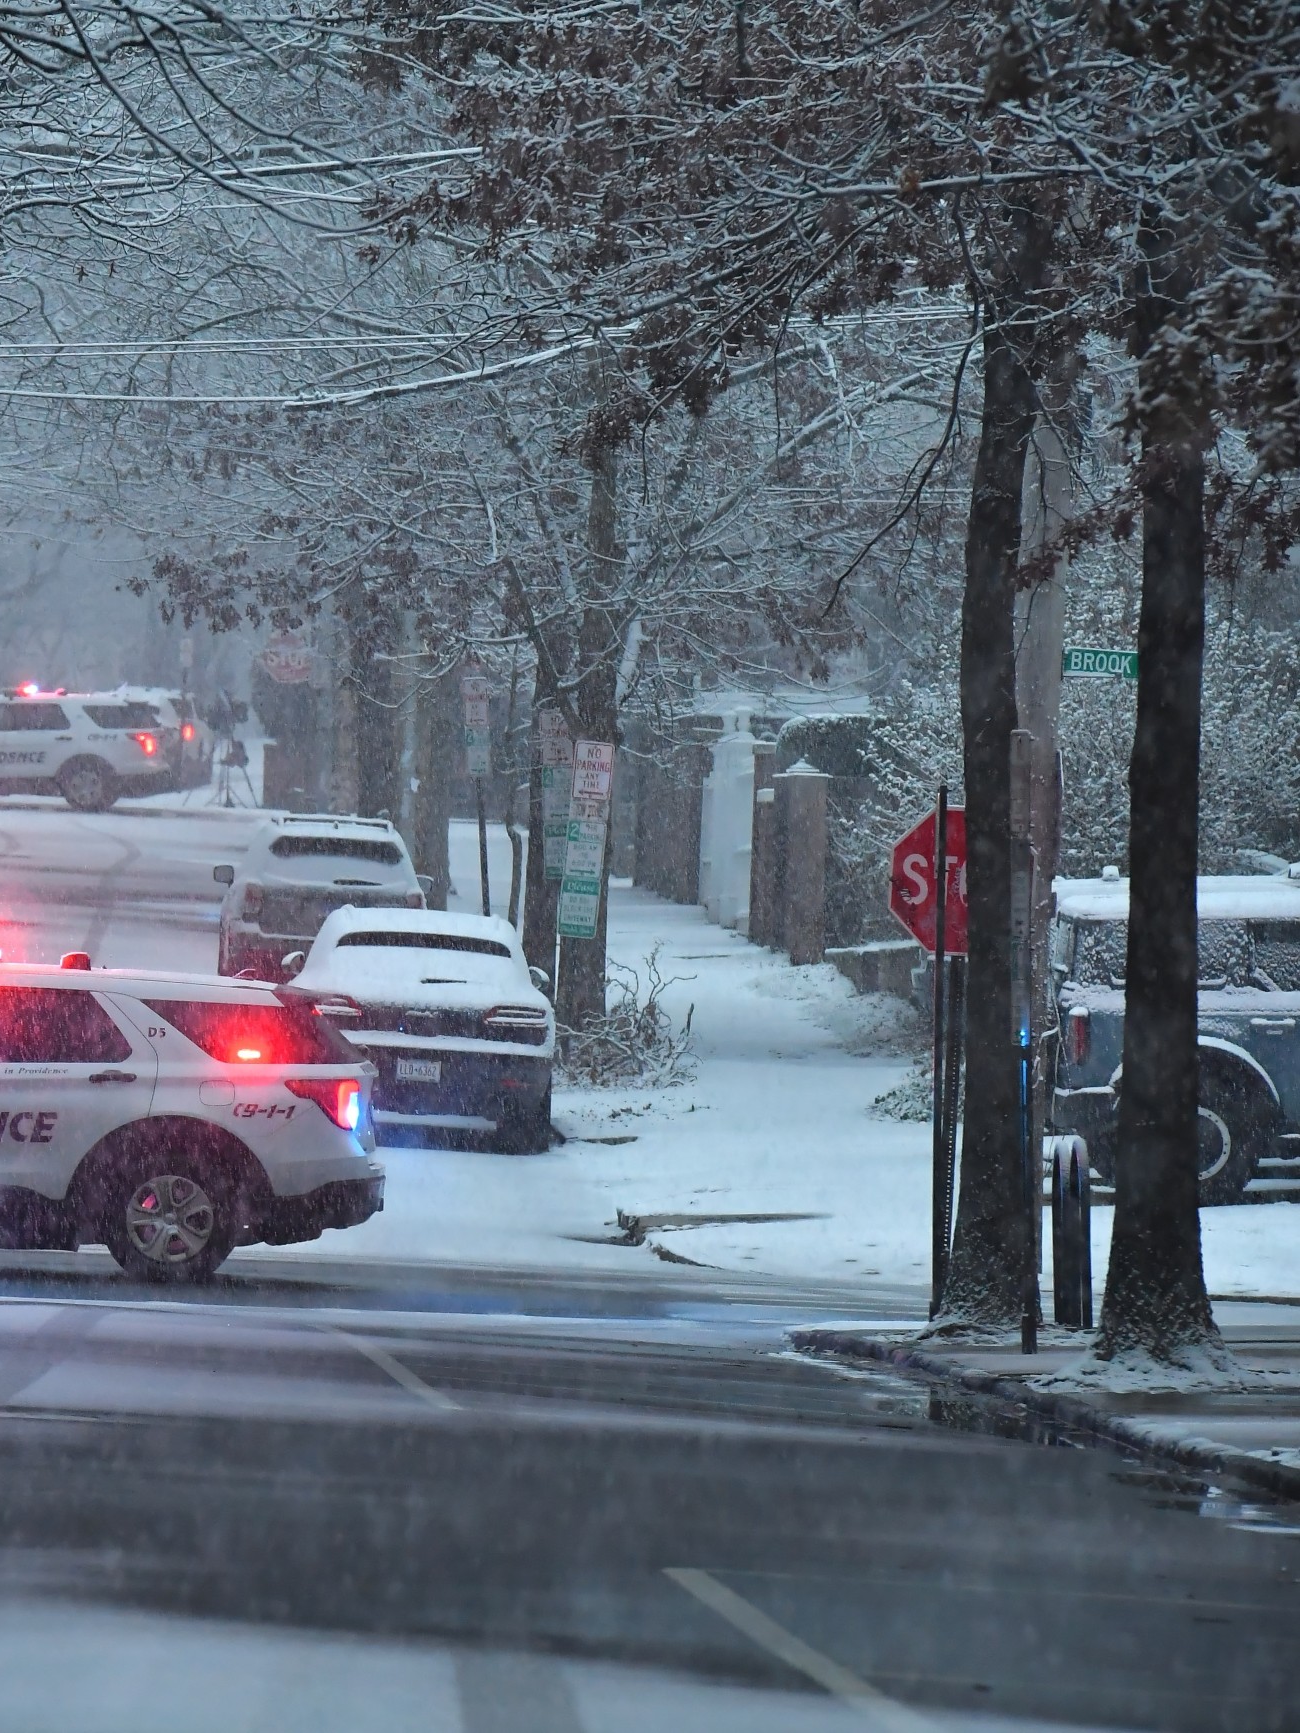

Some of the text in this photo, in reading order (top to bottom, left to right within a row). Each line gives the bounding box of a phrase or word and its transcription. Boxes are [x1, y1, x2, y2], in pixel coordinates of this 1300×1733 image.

[1070, 651, 1132, 674] BROOK
[587, 748, 602, 759] NO
[576, 759, 611, 773] PARKING
[585, 772, 599, 780] ANY
[583, 780, 600, 789] TIME
[570, 822, 580, 838] 2
[147, 1026, 167, 1038] D5
